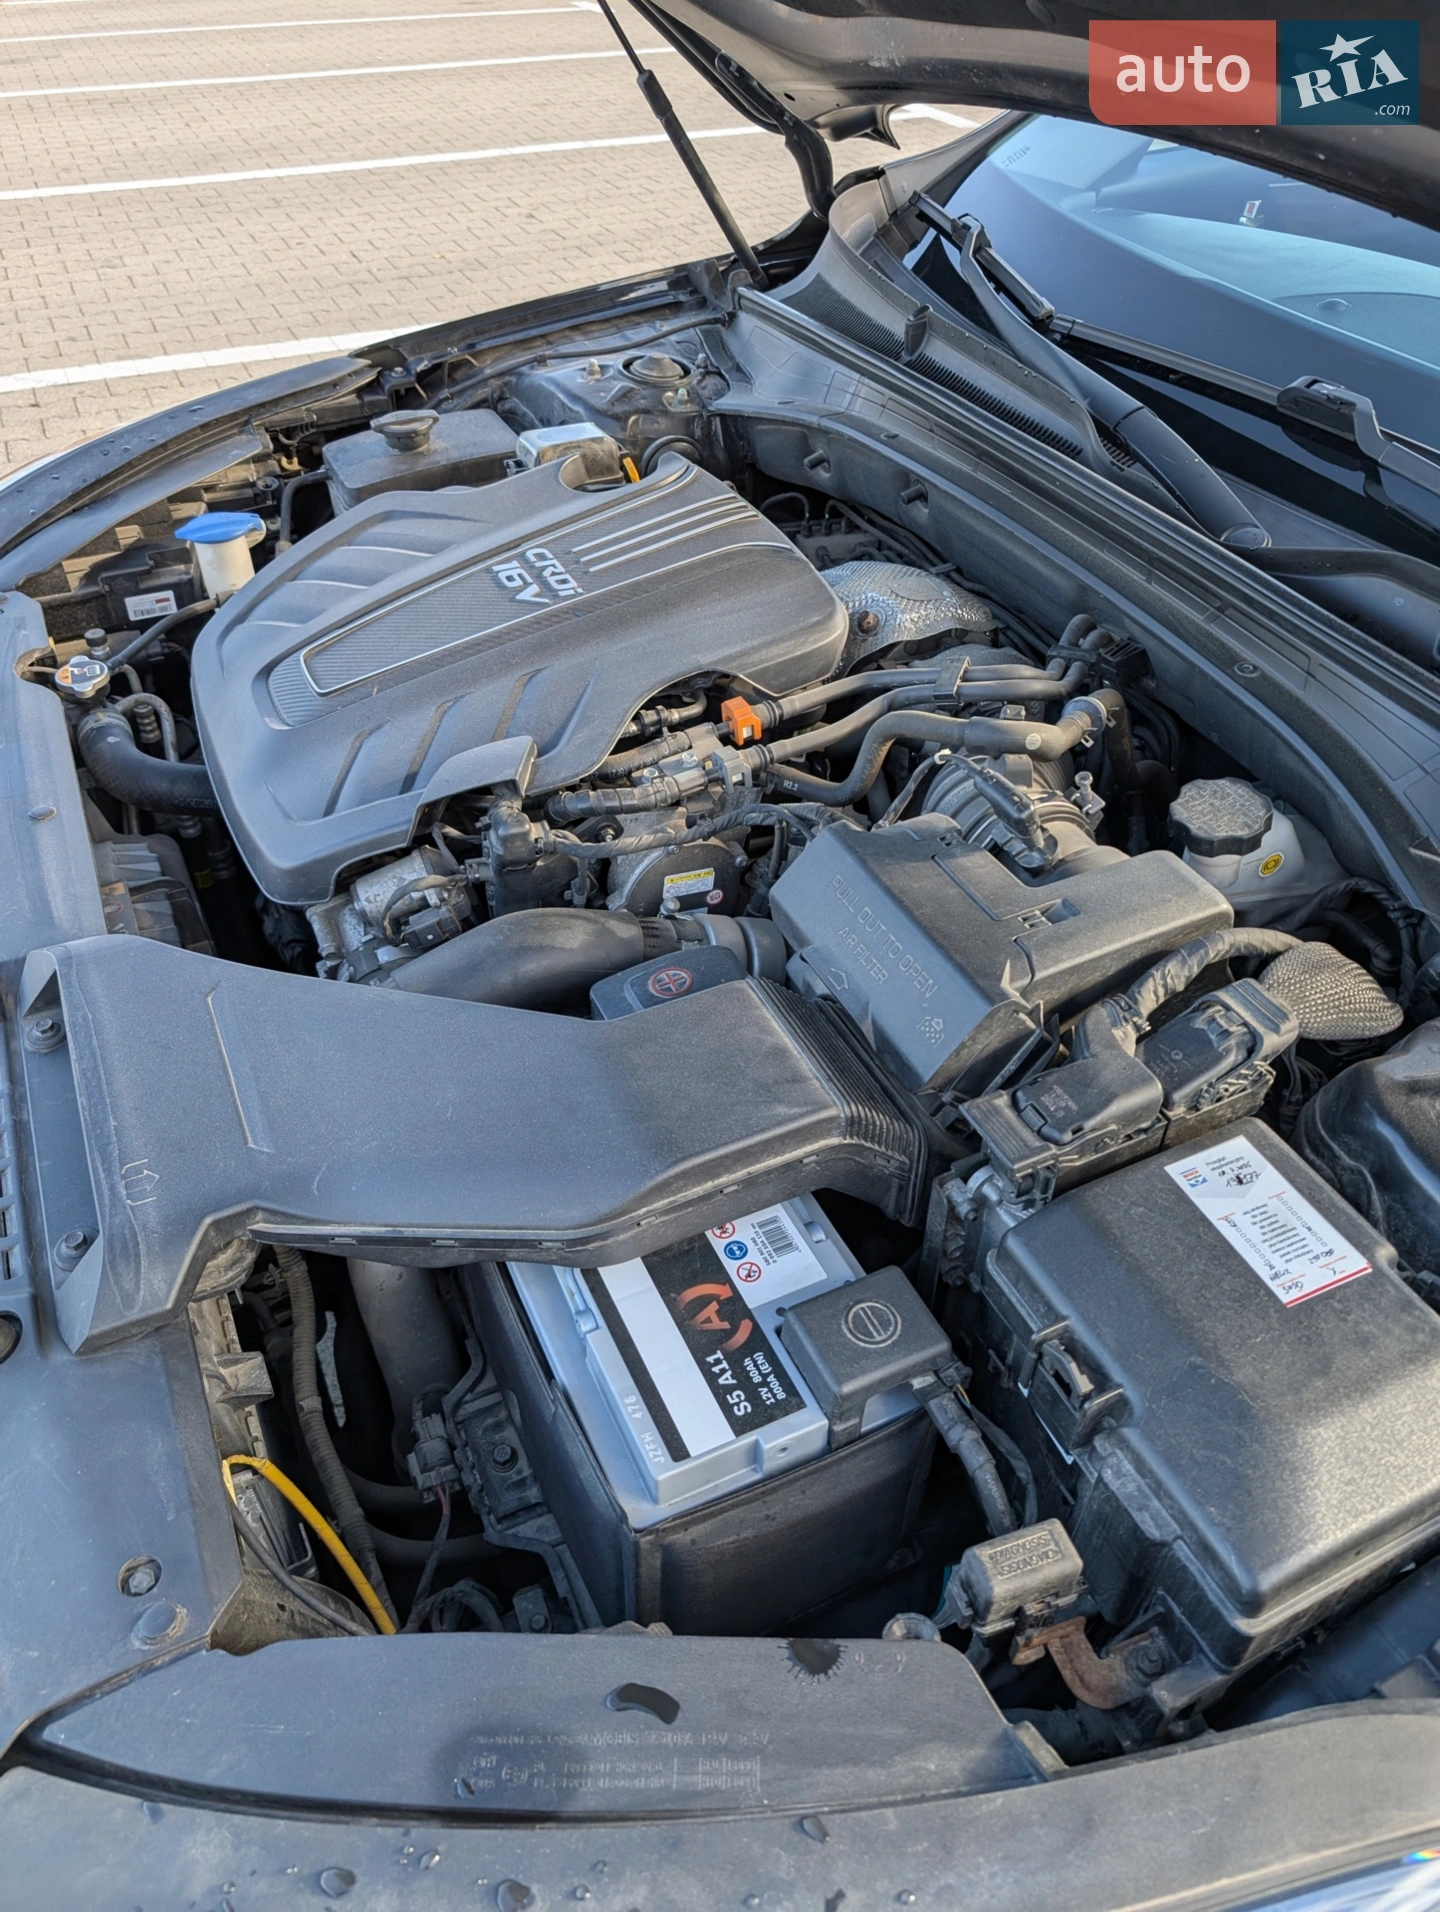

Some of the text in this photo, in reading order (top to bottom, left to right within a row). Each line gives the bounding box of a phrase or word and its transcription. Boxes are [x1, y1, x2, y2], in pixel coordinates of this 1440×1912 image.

[492, 560, 550, 604] 16V
[526, 548, 583, 597] CRDi
[829, 874, 938, 999] PULL OUT TO OPEN
[838, 926, 889, 985] AIR FILTER
[705, 1350, 752, 1417] S5 A11
[742, 1358, 776, 1406] 12V 80Ah
[753, 1351, 787, 1400] 800A (EN)
